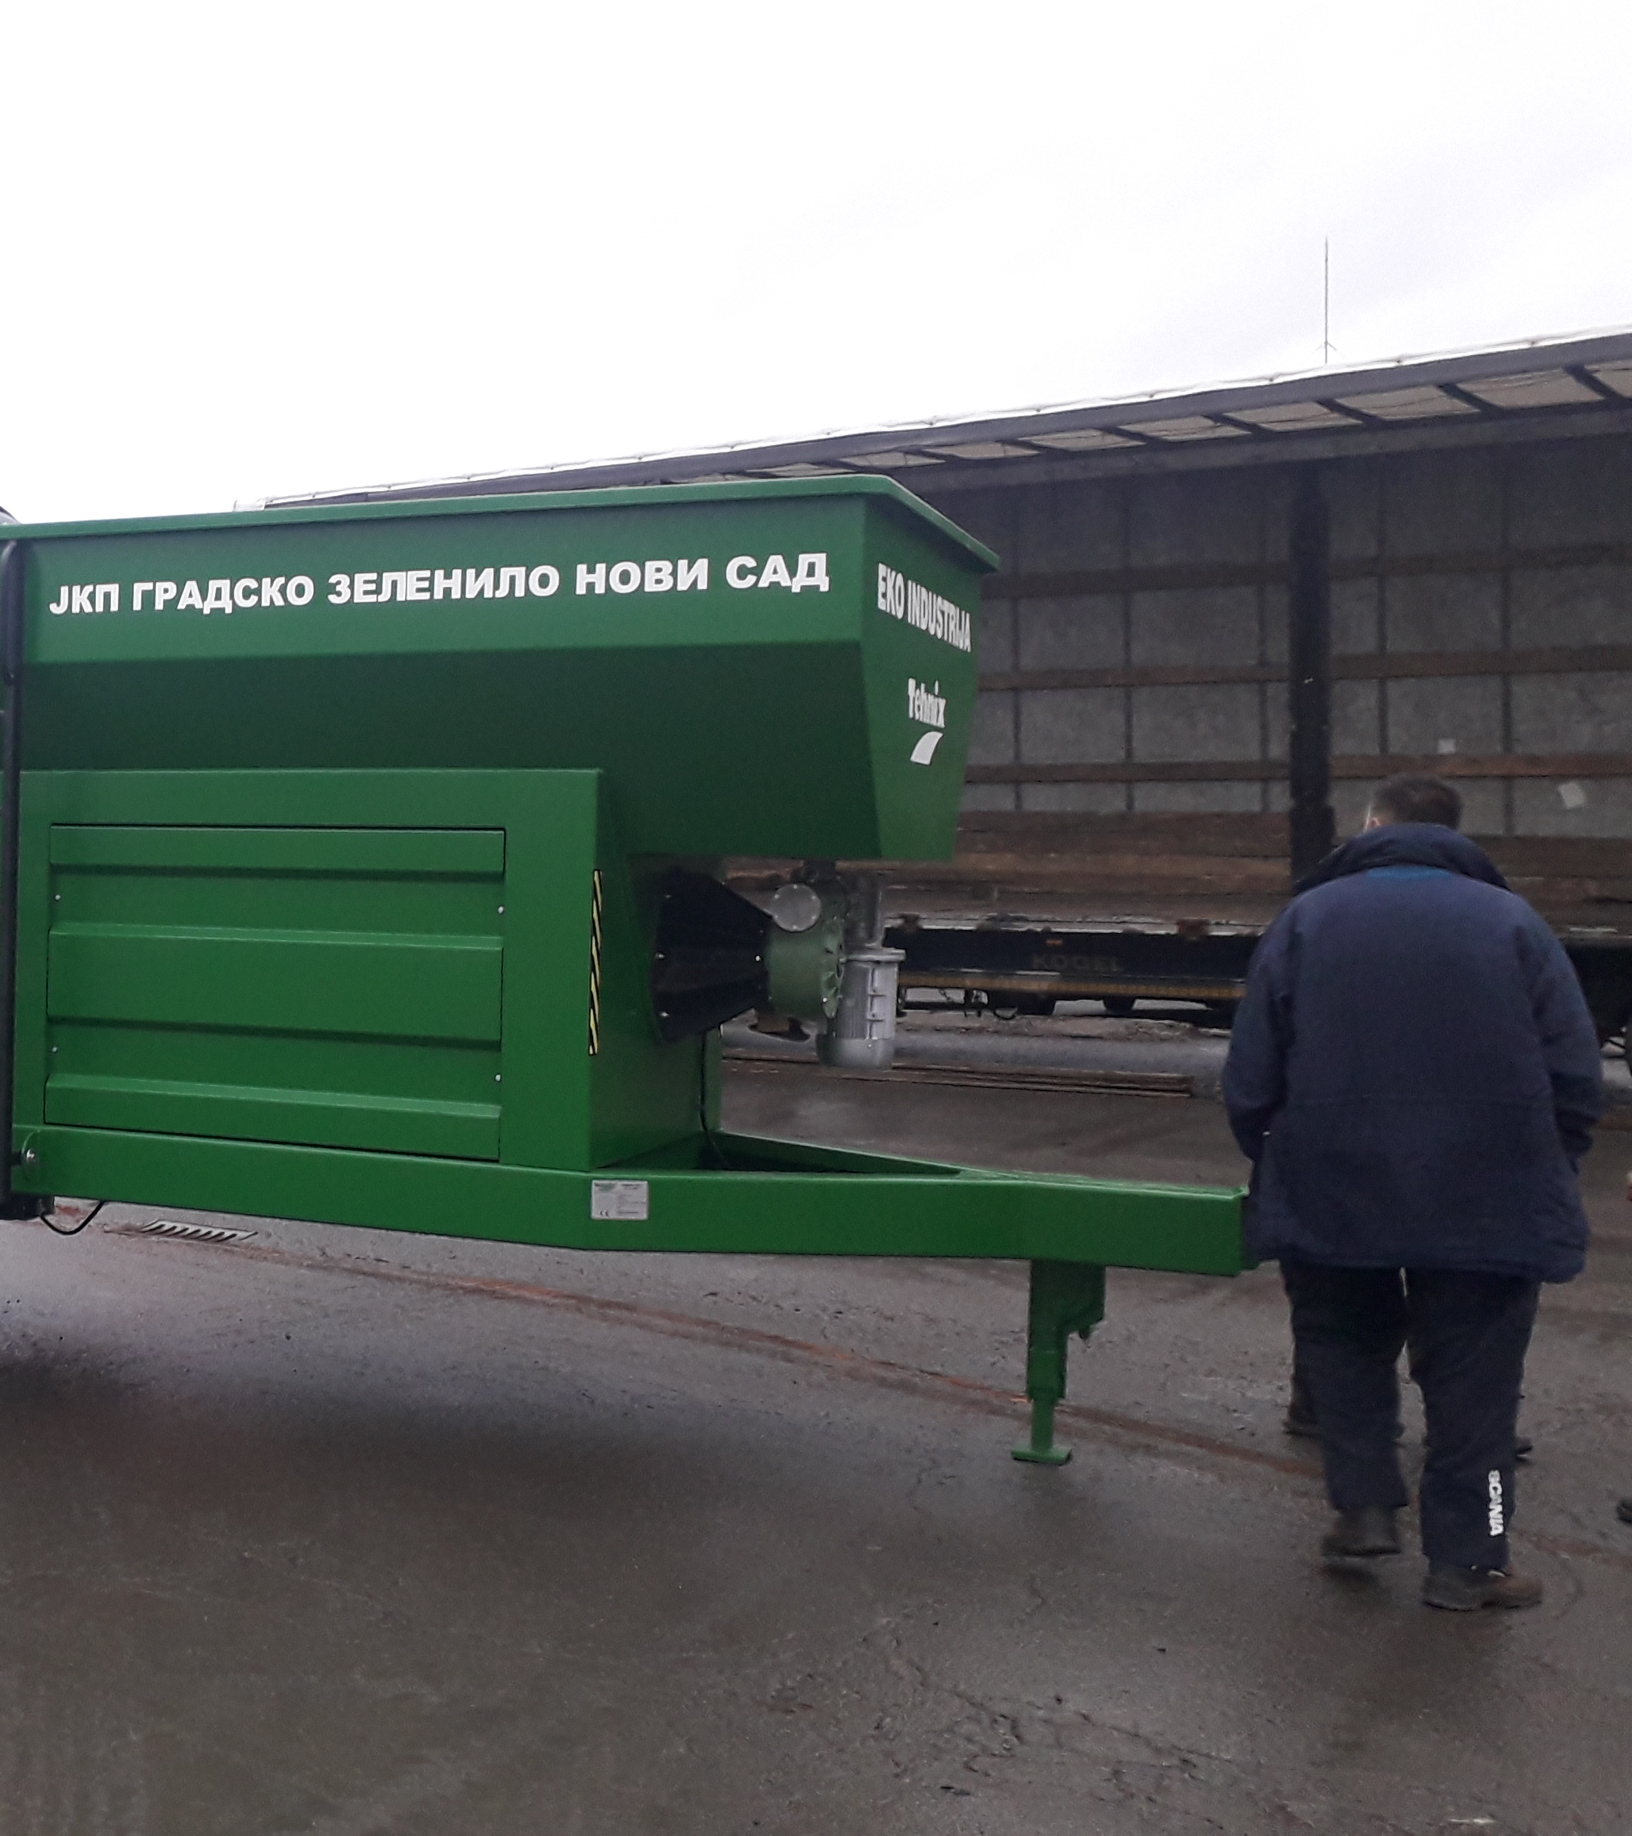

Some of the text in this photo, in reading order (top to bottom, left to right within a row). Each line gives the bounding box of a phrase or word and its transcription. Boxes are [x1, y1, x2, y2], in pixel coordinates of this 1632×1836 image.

[48, 552, 830, 615] ЈКП ГРАДСКО ЗЕЛЕНИЛО НОВИ САД
[877, 562, 972, 653] EKO INDUSTRIJA
[907, 677, 947, 728] Tehnix
[1488, 1469, 1504, 1537] SCANIA
